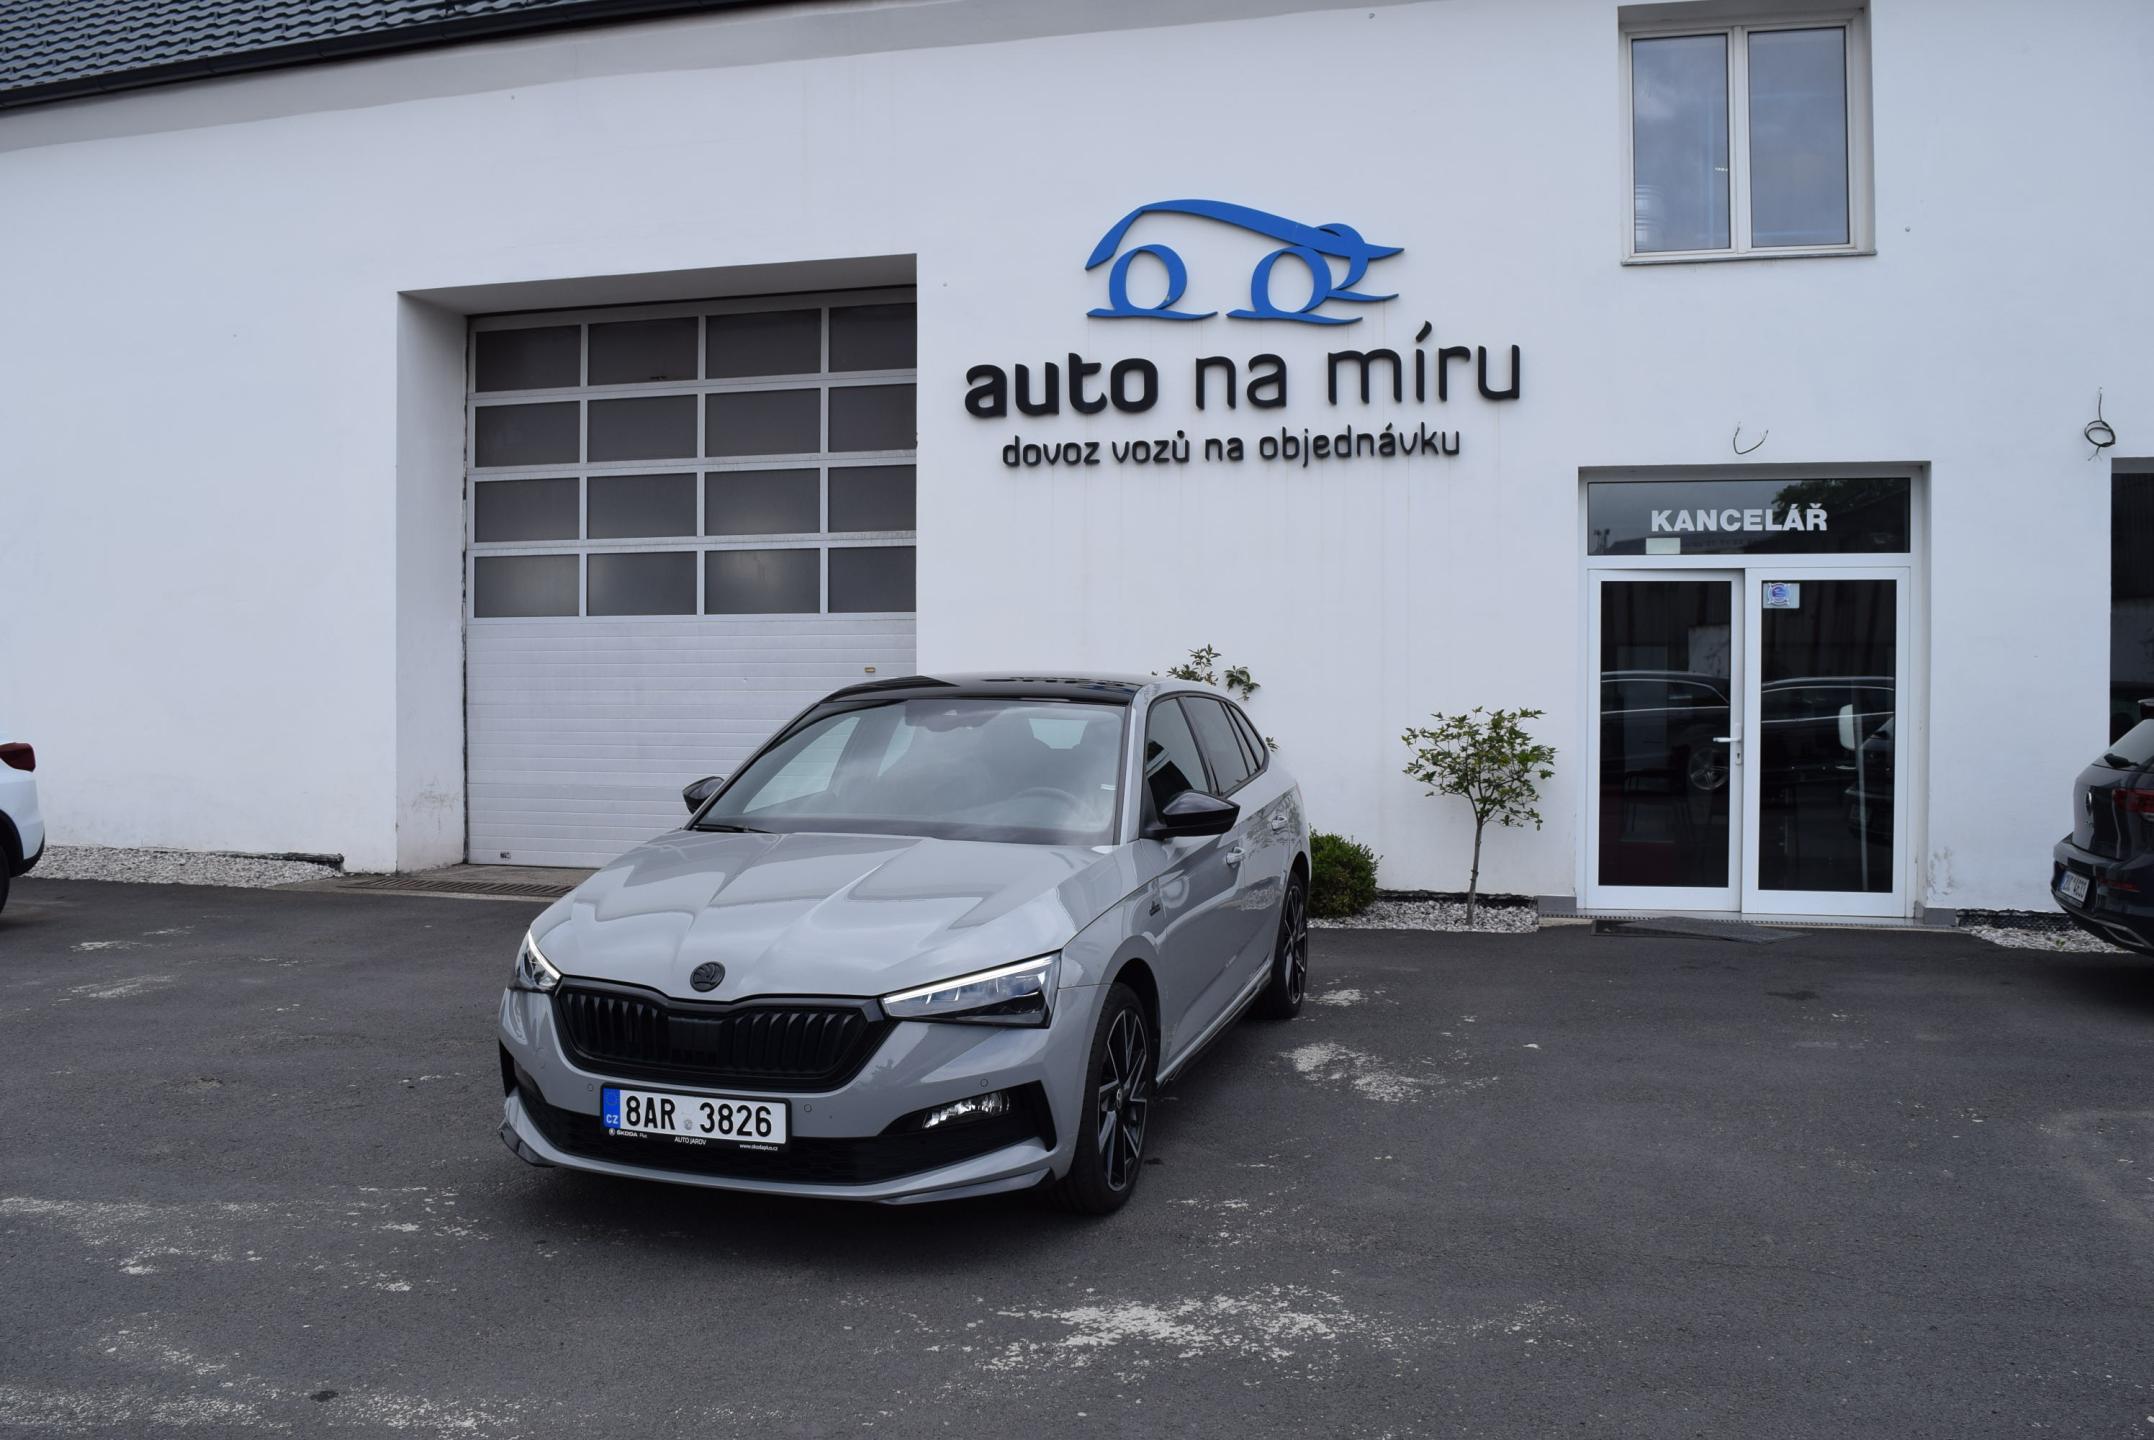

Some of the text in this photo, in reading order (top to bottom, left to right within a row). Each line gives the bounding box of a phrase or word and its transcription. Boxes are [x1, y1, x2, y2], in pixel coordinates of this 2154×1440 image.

[964, 320, 1521, 418] auto na míru
[1002, 422, 1461, 468] dovoz vozů na objednávku
[1651, 503, 1828, 532] KANCELÁŘ
[606, 1114, 619, 1125] CZ
[625, 1095, 772, 1137] 8AR 3826
[674, 1136, 690, 1144] AUTO
